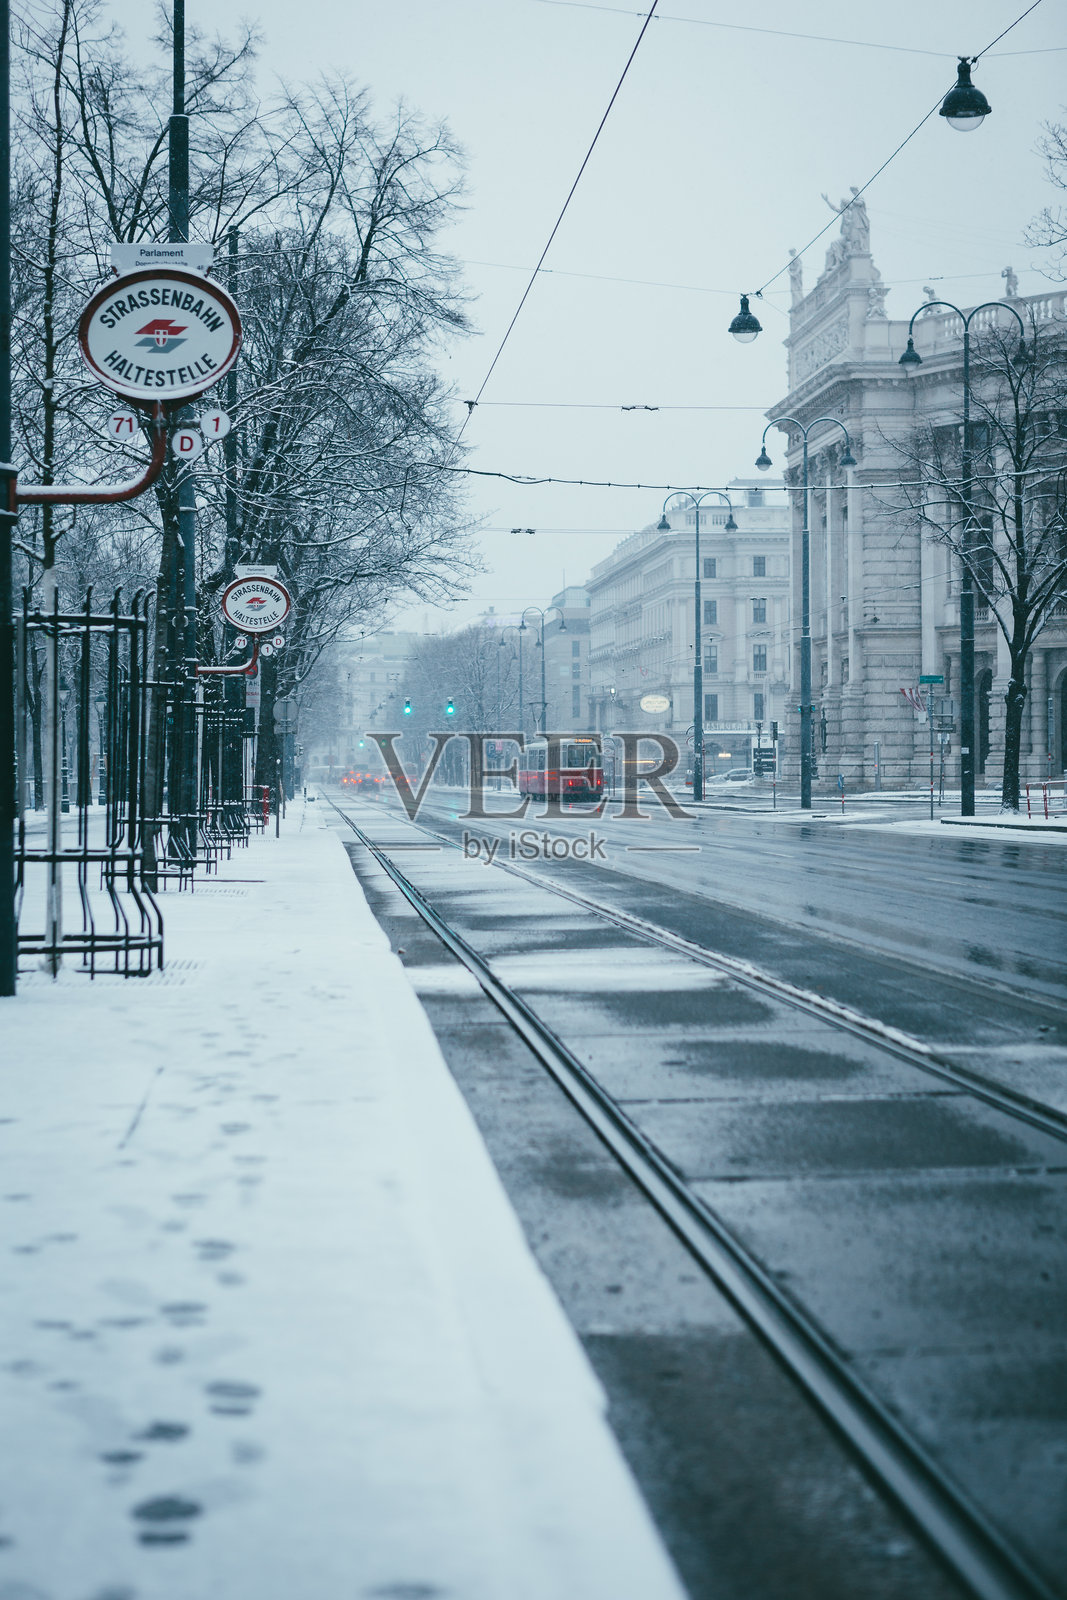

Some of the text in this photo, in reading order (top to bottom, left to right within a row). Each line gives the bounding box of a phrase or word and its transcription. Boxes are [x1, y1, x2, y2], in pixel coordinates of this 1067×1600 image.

[140, 249, 184, 257] Parlament
[99, 288, 225, 333] STRASSENBAHN
[103, 350, 218, 387] HALTESTELLE
[113, 417, 133, 433] 71
[212, 417, 220, 432] 1
[180, 436, 194, 452] D
[231, 584, 282, 604] STRASSENBAHN
[233, 609, 280, 626] HALTESTELLE
